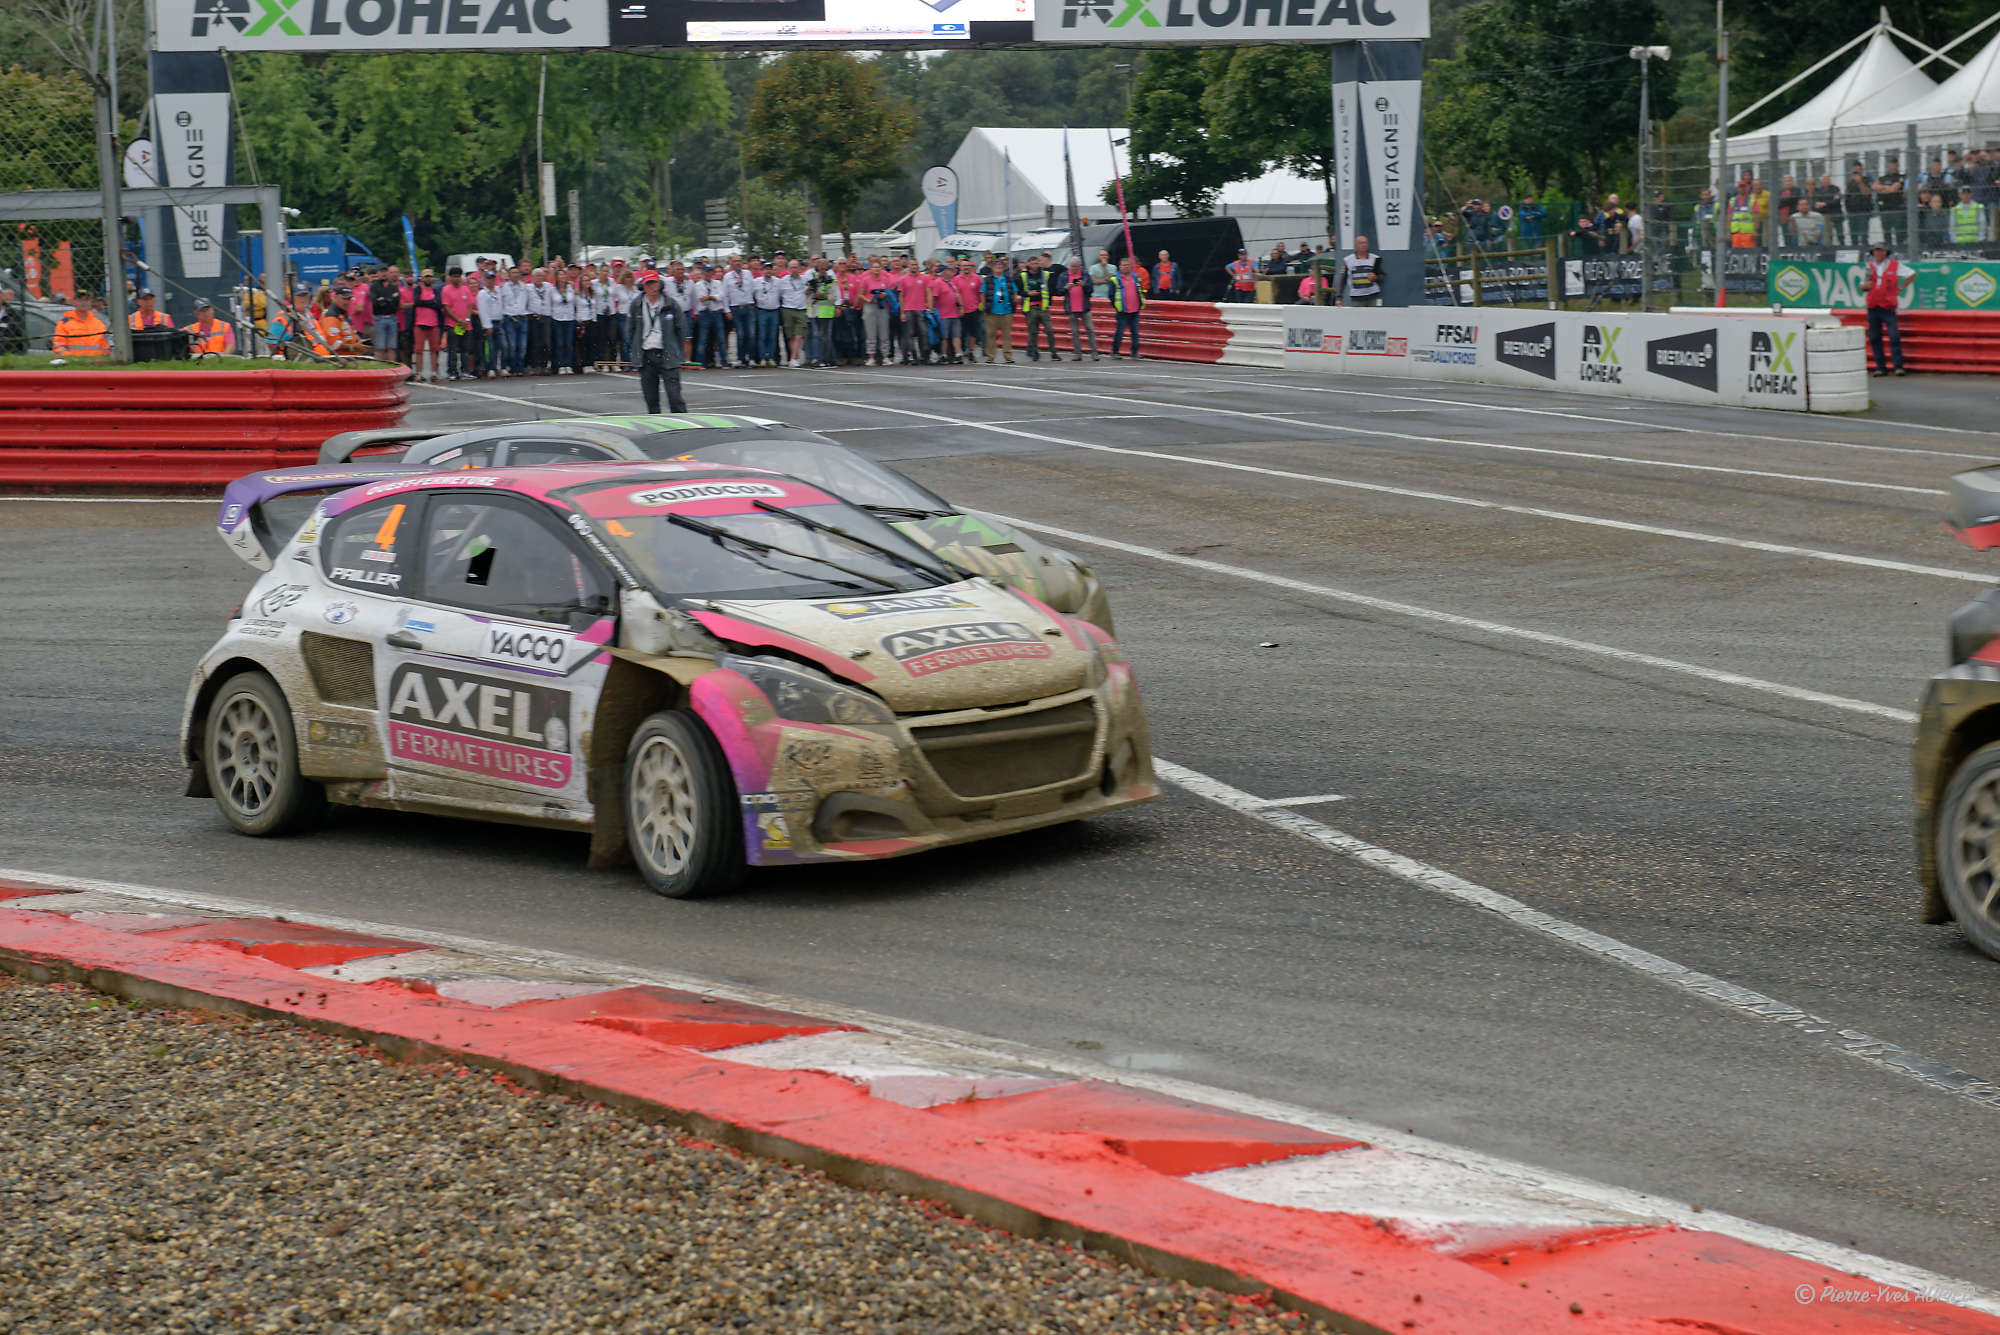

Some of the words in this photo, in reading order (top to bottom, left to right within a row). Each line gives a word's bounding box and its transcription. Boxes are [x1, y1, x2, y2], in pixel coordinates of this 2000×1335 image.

[310, 0, 573, 35] LOHEAC
[1166, 0, 1397, 27] LOHEAC
[1383, 113, 1400, 227] BRETAGNE
[186, 129, 209, 251] BREGNE
[1436, 325, 1473, 344] FFSA
[1503, 340, 1547, 358] BRETAGNE
[1580, 364, 1621, 384] LOHEAC
[1656, 350, 1707, 367] BRETAGNE
[1749, 373, 1798, 395] LOHEAC
[640, 485, 777, 503] PODIOCOM
[374, 503, 406, 550] 4
[491, 630, 564, 664] YACCO
[891, 625, 1011, 657] AXEL
[908, 643, 1051, 674] FERMETURES
[391, 671, 544, 742] AXEL
[397, 729, 566, 782] FERMETURES
